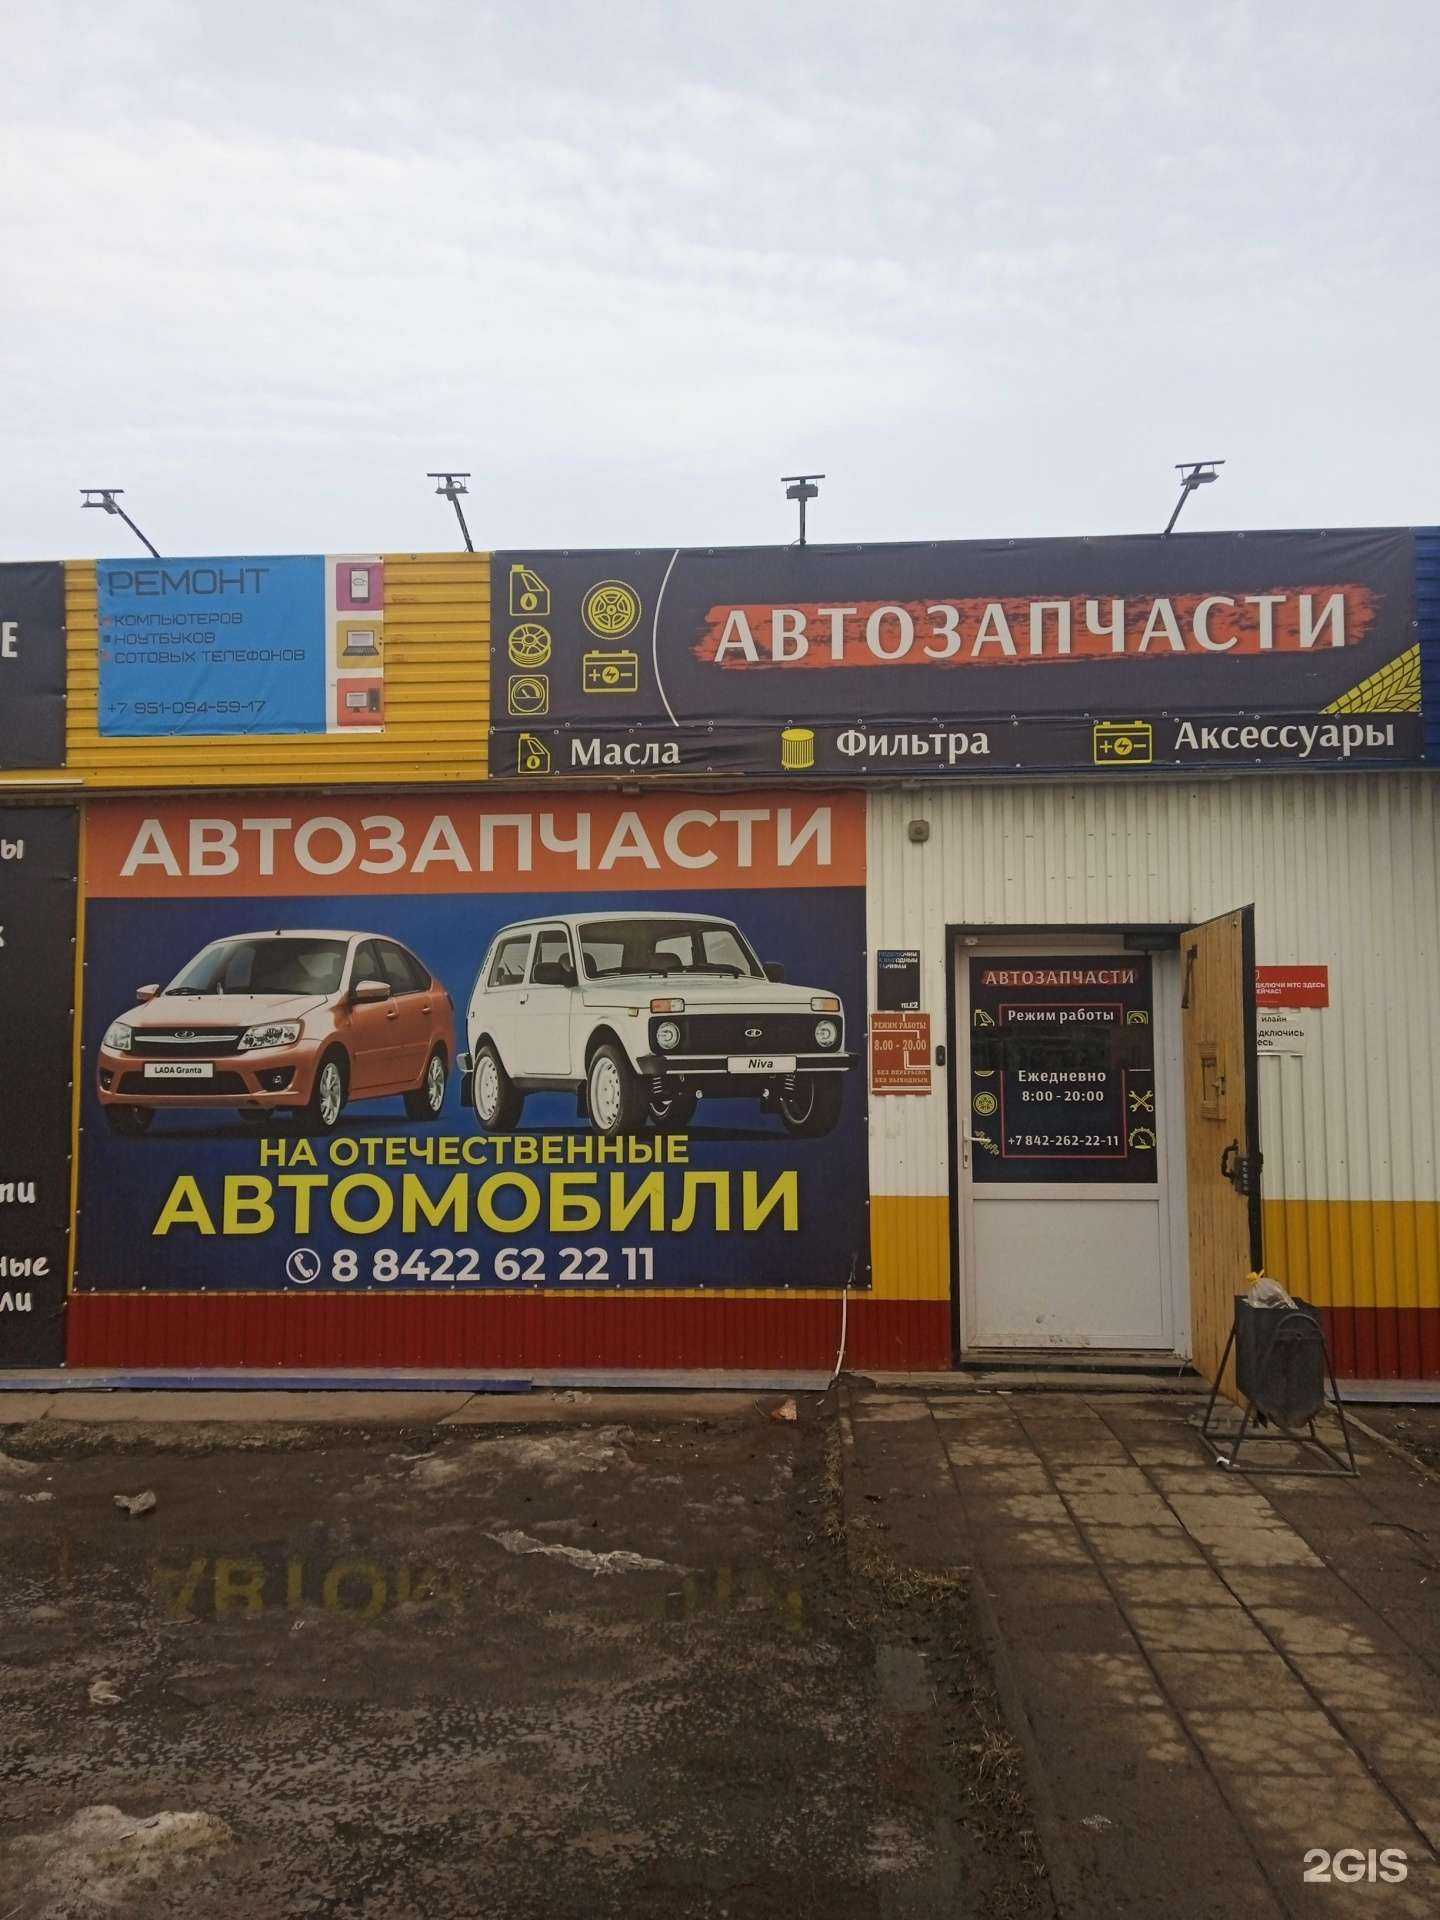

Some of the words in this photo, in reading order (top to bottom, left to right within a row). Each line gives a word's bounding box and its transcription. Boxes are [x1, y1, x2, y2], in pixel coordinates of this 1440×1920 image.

[108, 568, 269, 598] РЕМОНТ
[114, 612, 243, 627] КОМПЬЮТЕРОВ
[713, 591, 1348, 664] АВТОЗАПЧАСТИ
[114, 631, 216, 646] НОУТБУКОВ
[114, 649, 197, 665] СОТОВЫХ
[202, 648, 305, 663] ТЕЛЕФОНОВ
[107, 701, 128, 714] +7
[134, 700, 266, 714] 951-094-59-17
[835, 724, 990, 761] Фильтра
[1173, 719, 1396, 757] Аксессуары
[570, 736, 681, 766] Масла
[119, 806, 832, 878] АВТОЗАПЧАСТИ
[985, 970, 1135, 986] АВТОЗАПЧАСТИ
[1008, 1009, 1056, 1023] Режим
[1058, 1009, 1114, 1025] работы
[1258, 1029, 1305, 1038] дключись
[874, 1039, 893, 1051] 8.00
[902, 1039, 927, 1051] 20.00
[154, 1066, 175, 1074] LADA
[176, 1066, 202, 1074] Granta
[747, 1058, 774, 1070] Niva
[1018, 1070, 1107, 1085] Ежедневно
[1021, 1090, 1053, 1103] 8:00
[1064, 1090, 1105, 1103] 20:00
[1008, 1135, 1023, 1147] +7
[1025, 1135, 1120, 1147] 842-262-22-11
[258, 1138, 318, 1168] НА
[328, 1134, 690, 1167] ОТЕЧЕСТВЕННЫЕ
[151, 1170, 800, 1237] АВТОМОБИЛИ
[331, 1249, 359, 1282] 8
[371, 1249, 481, 1282] 8422
[493, 1248, 547, 1282] 62
[558, 1248, 610, 1282] 22
[625, 1247, 655, 1281] 11
